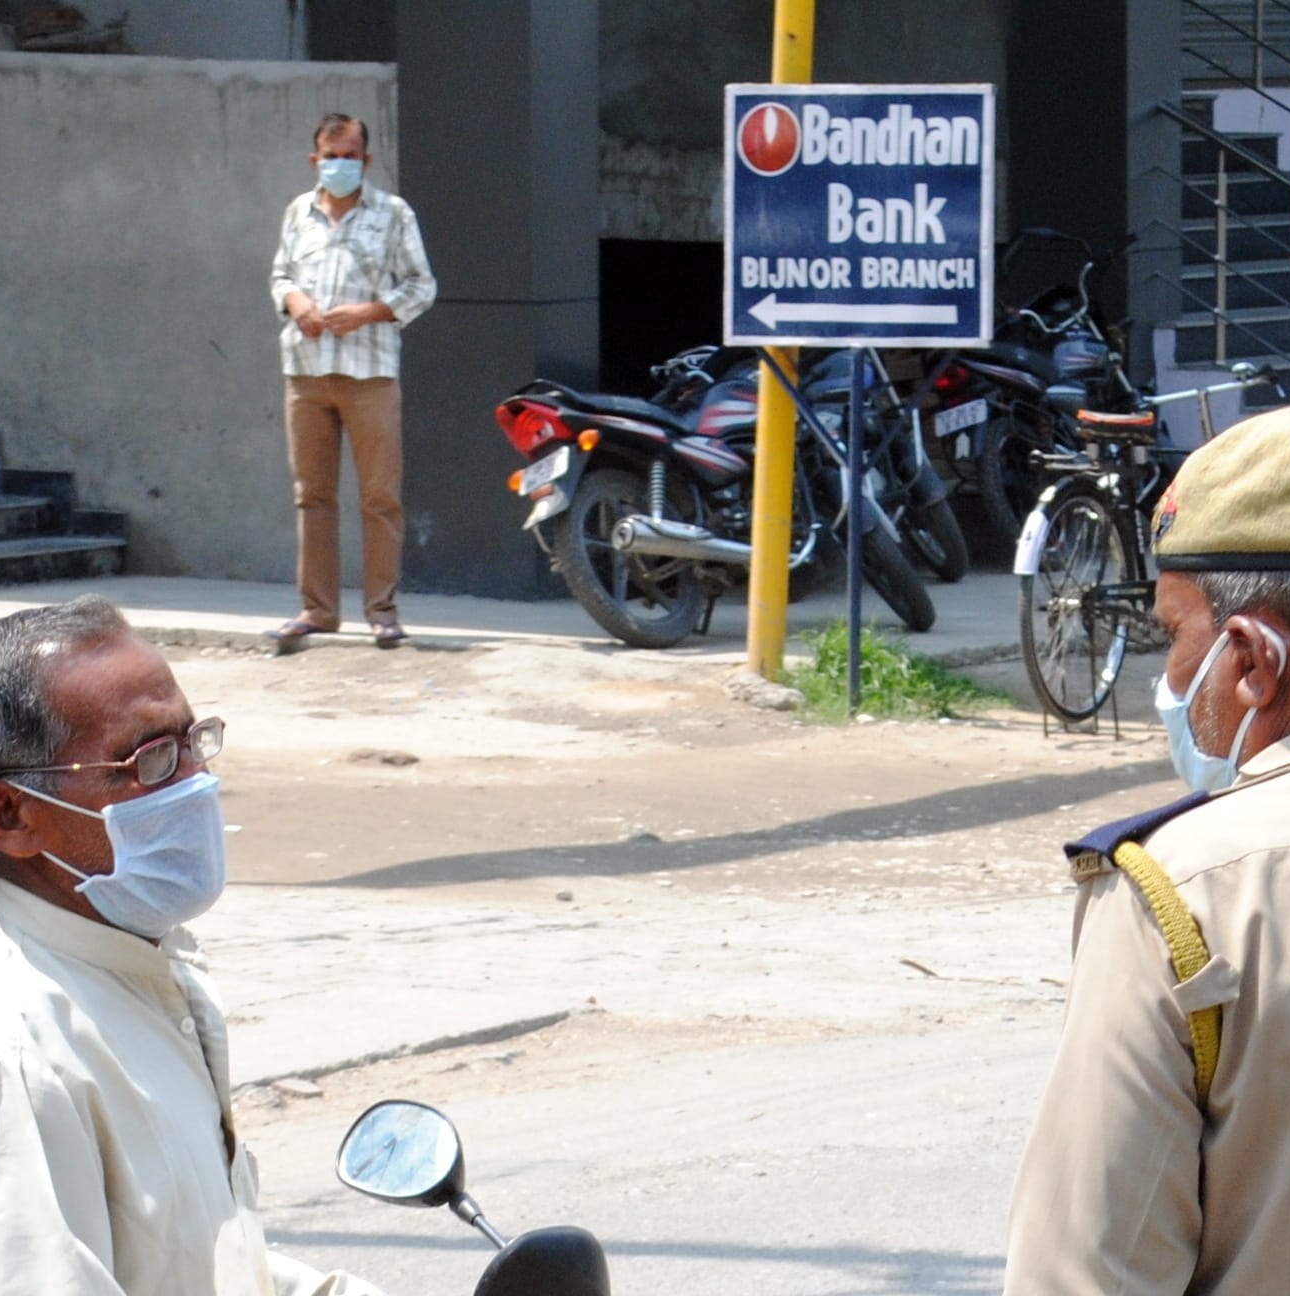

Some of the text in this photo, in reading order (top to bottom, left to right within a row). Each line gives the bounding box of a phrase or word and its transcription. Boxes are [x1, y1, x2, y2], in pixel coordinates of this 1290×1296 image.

[802, 103, 979, 166] Bandhan
[828, 182, 948, 244] Bank
[741, 256, 975, 289] BIJNOR BRANCH
